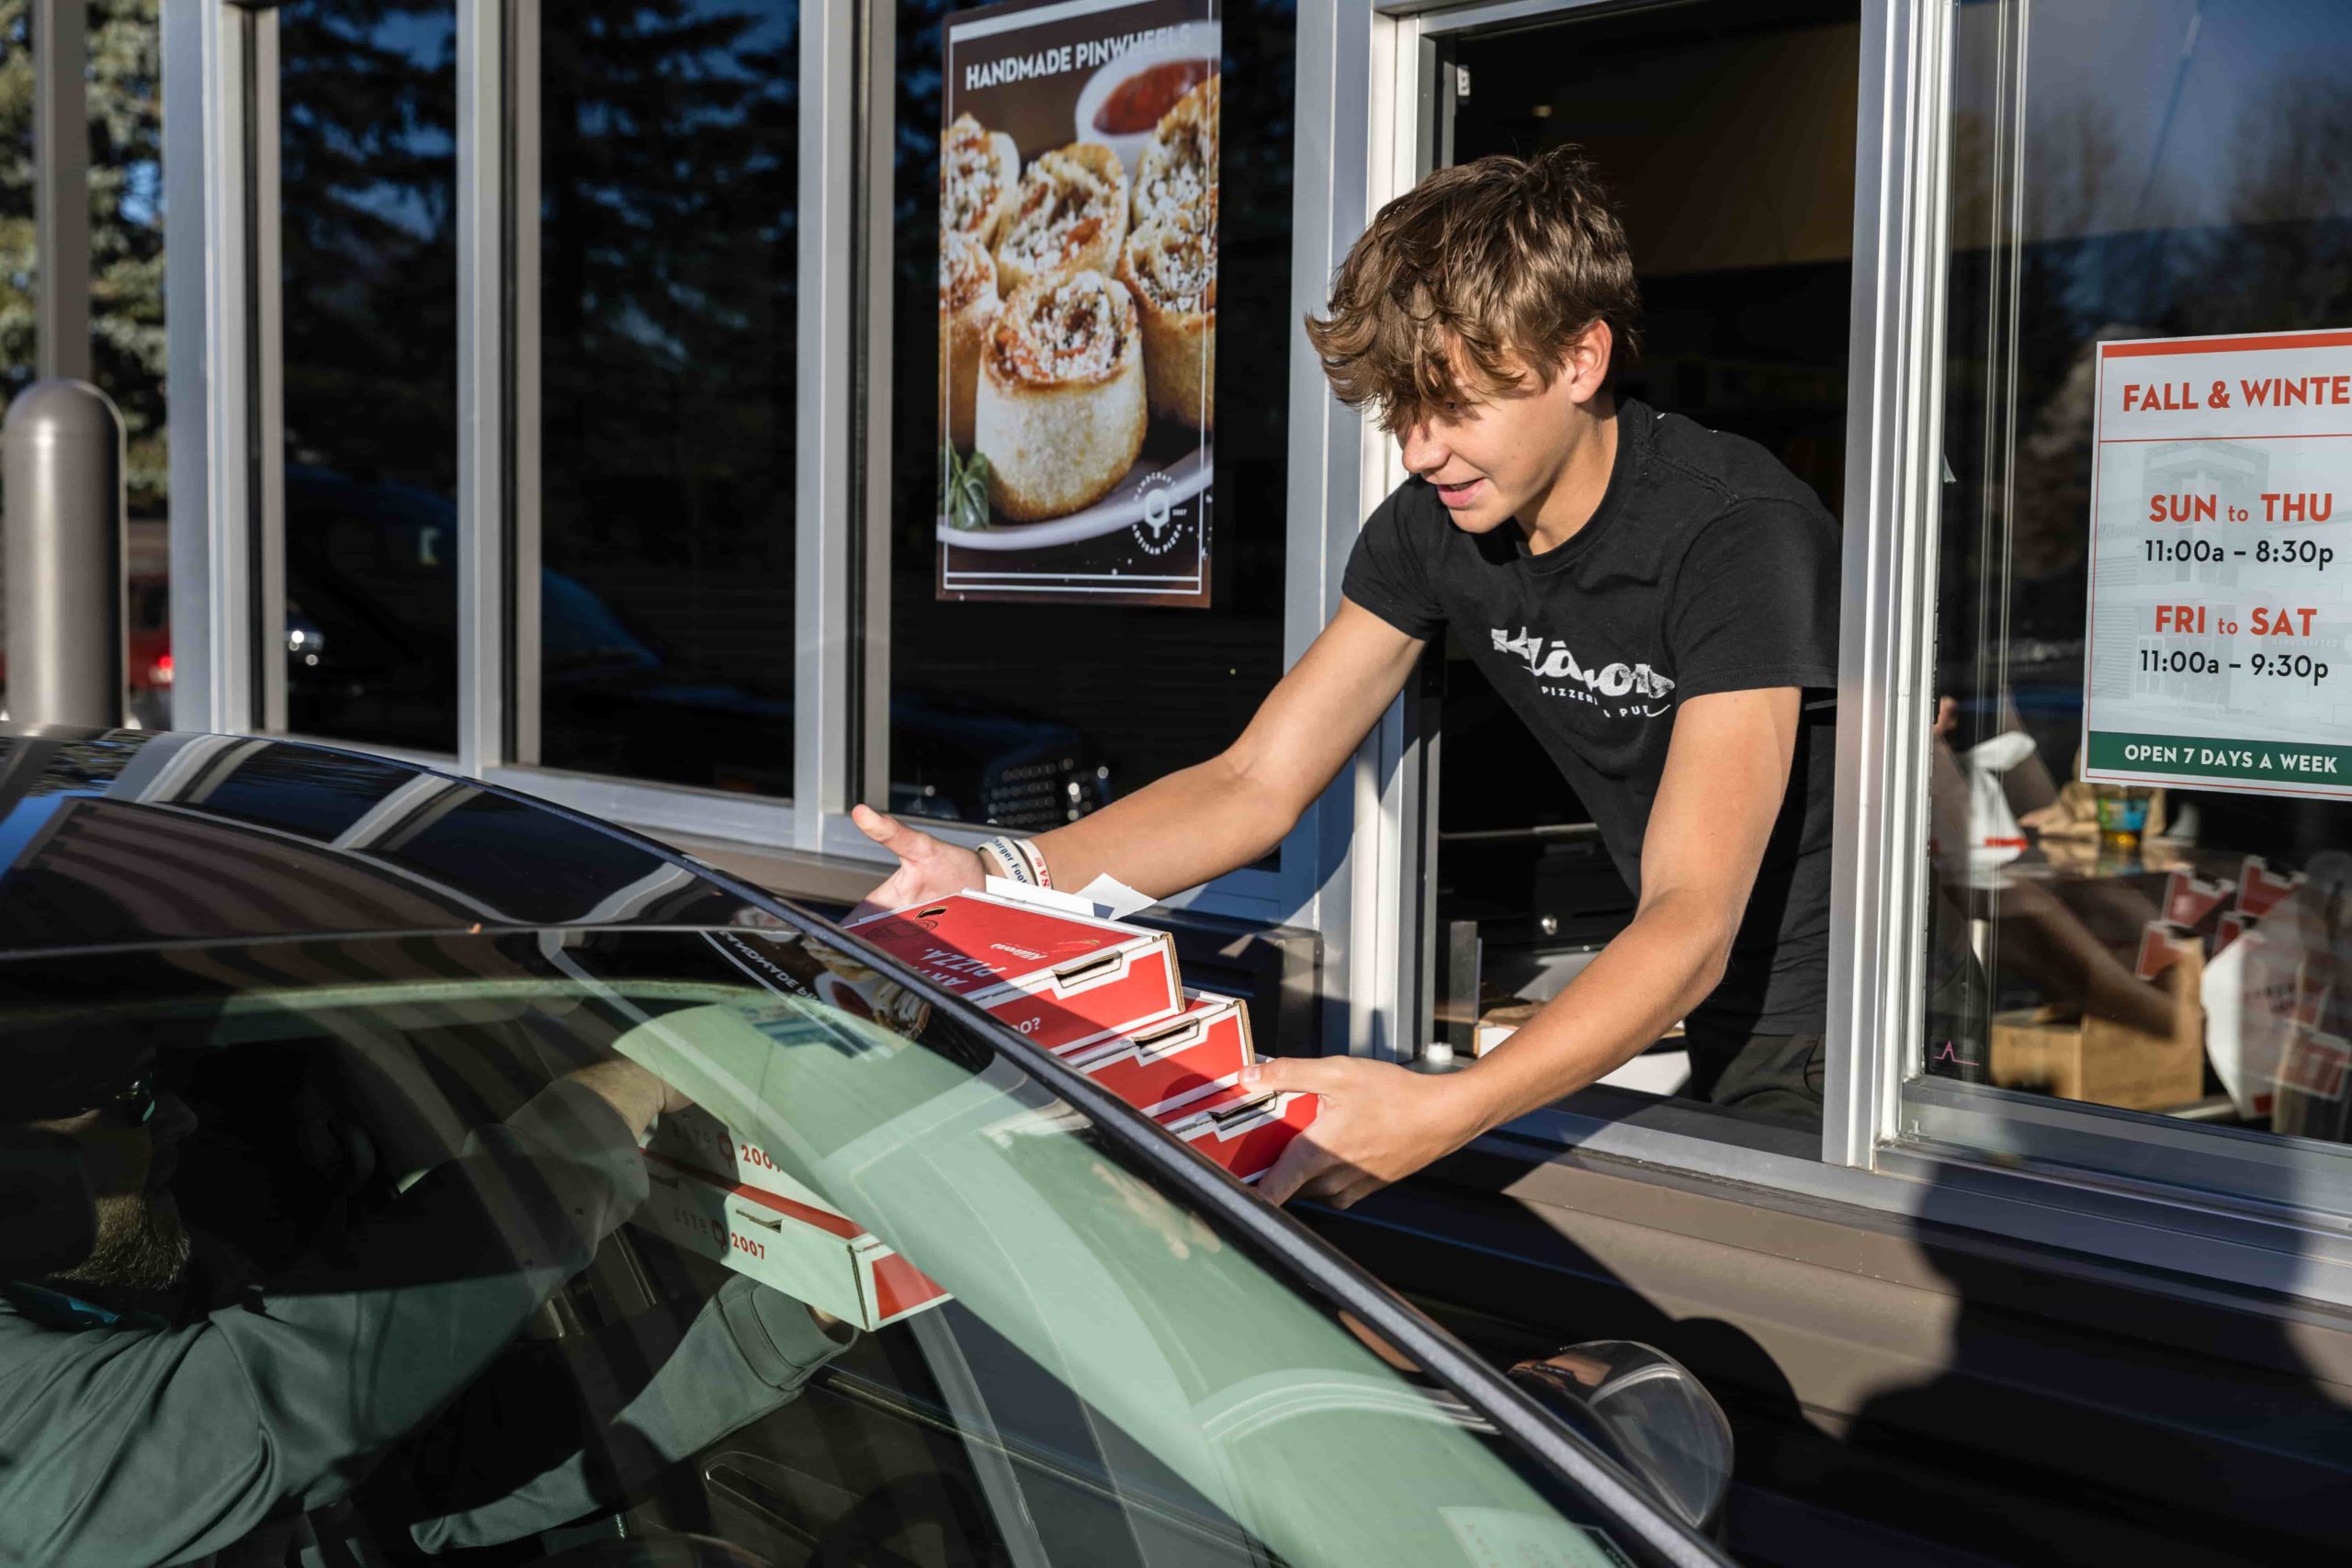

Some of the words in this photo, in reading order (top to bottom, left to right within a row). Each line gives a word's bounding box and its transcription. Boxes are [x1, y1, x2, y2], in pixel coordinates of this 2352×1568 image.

[966, 47, 1071, 91] HANDMADE
[1076, 23, 1191, 69] PINWHEELS
[2123, 382, 2199, 412] FALL
[2208, 380, 2231, 409] &
[2240, 376, 2351, 407] WINTE
[2149, 493, 2217, 522] SUN
[2228, 505, 2249, 522] to
[2261, 493, 2333, 522] THU
[2145, 539, 2224, 562] 11:00a
[2256, 540, 2334, 571] 8:30p
[2155, 605, 2206, 633] FRI
[2218, 617, 2238, 635] to
[2250, 607, 2318, 637] SAT
[2141, 650, 2220, 674] 11:00a
[2251, 654, 2328, 686] 9:30p
[2124, 744, 2177, 762] OPEN
[2184, 748, 2196, 764] 7
[2201, 749, 2254, 768] DAYS
[2259, 753, 2273, 769] A
[2279, 753, 2338, 773] WEEK
[731, 1233, 765, 1259] 2007
